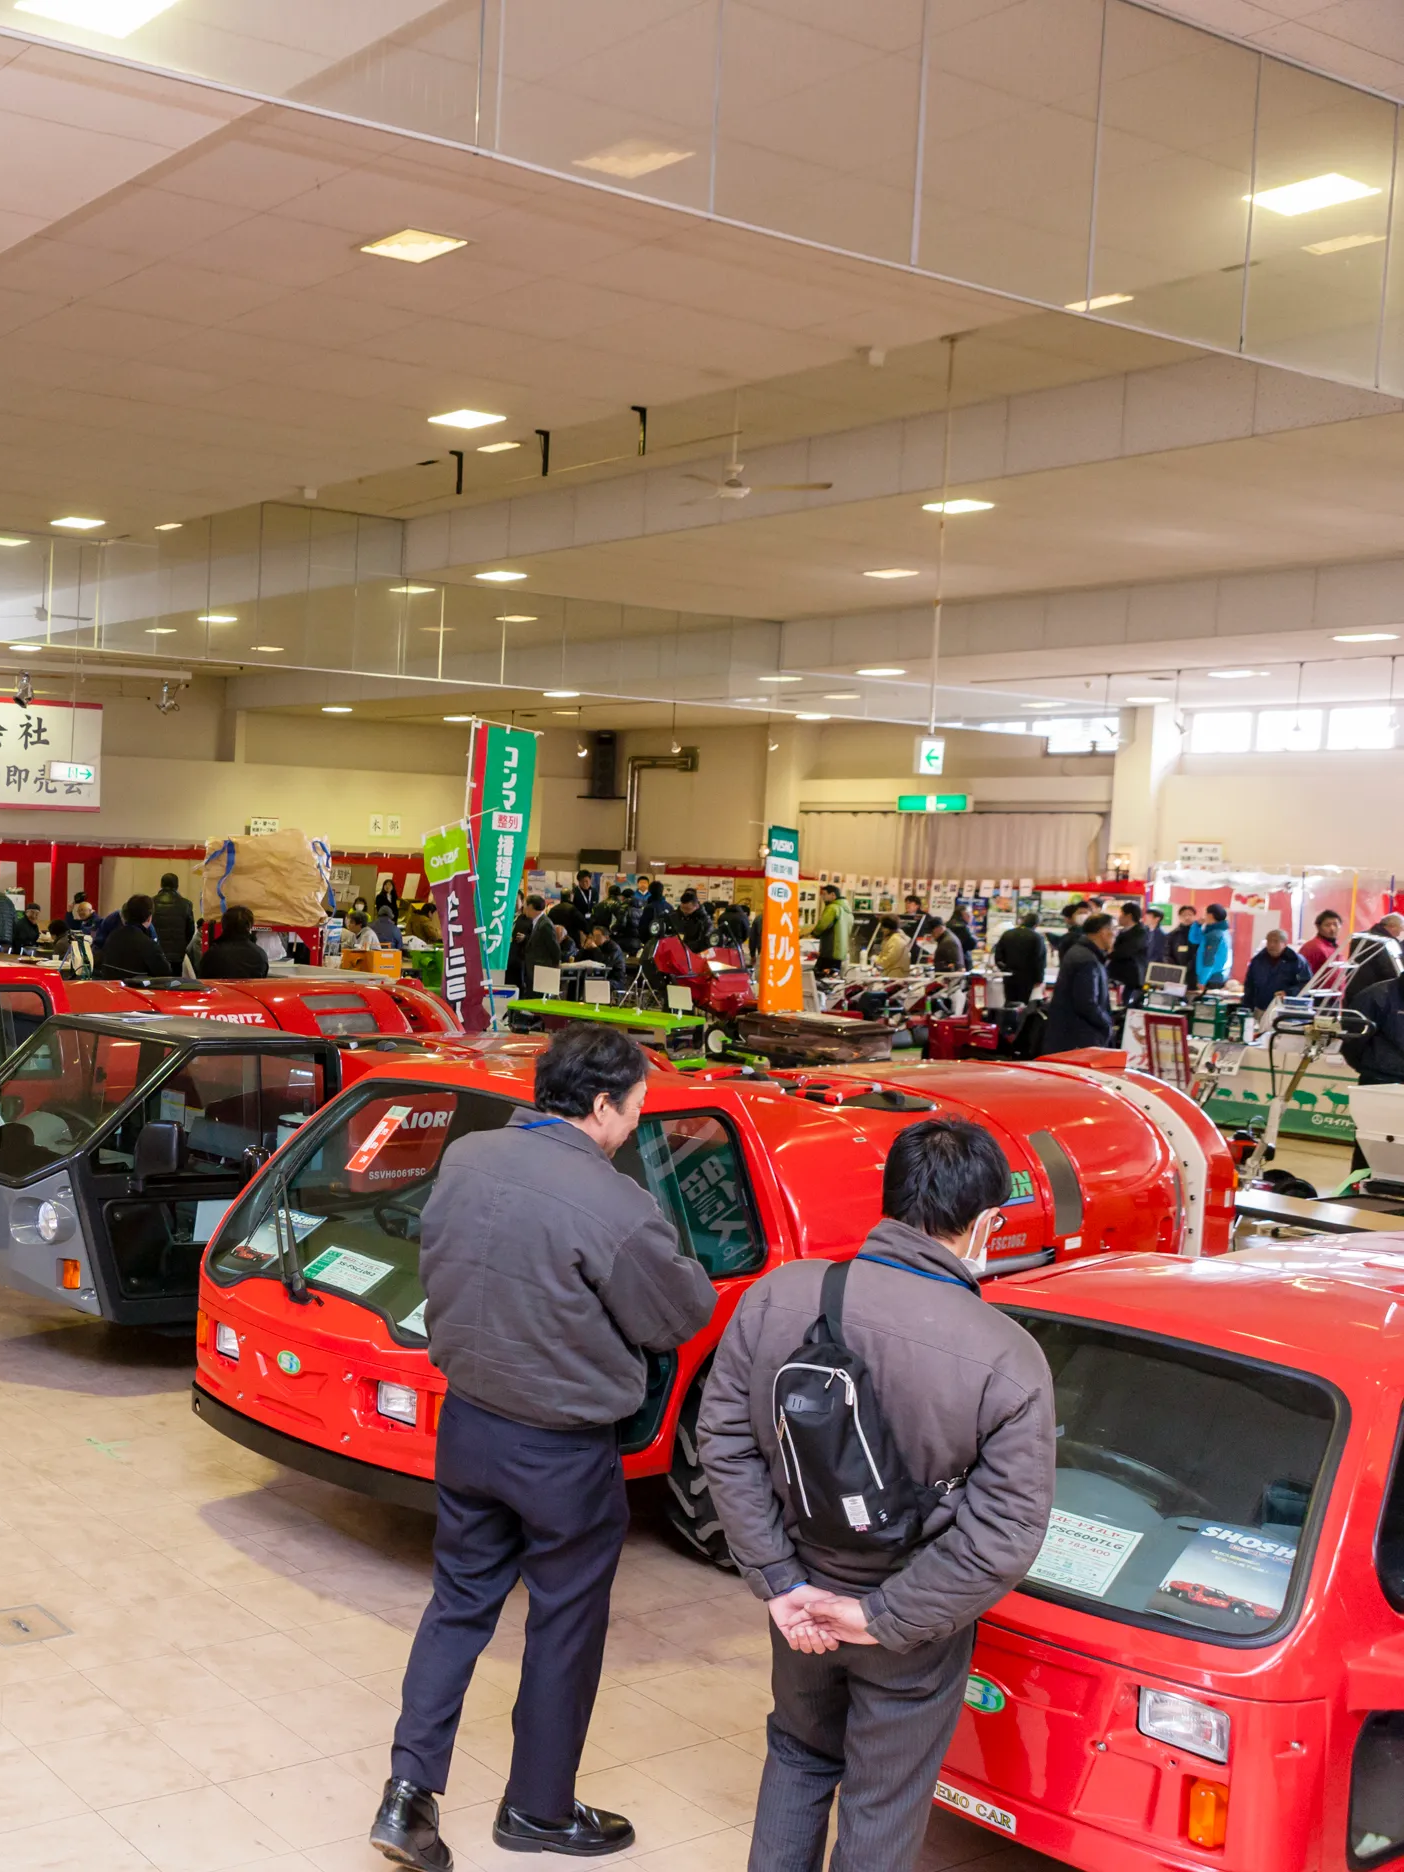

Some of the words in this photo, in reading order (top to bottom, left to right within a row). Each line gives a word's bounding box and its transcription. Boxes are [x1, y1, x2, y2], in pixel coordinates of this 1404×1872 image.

[502, 746, 519, 811] コンマ
[497, 814, 519, 829] 整列
[975, 1801, 1012, 1830] CAR
